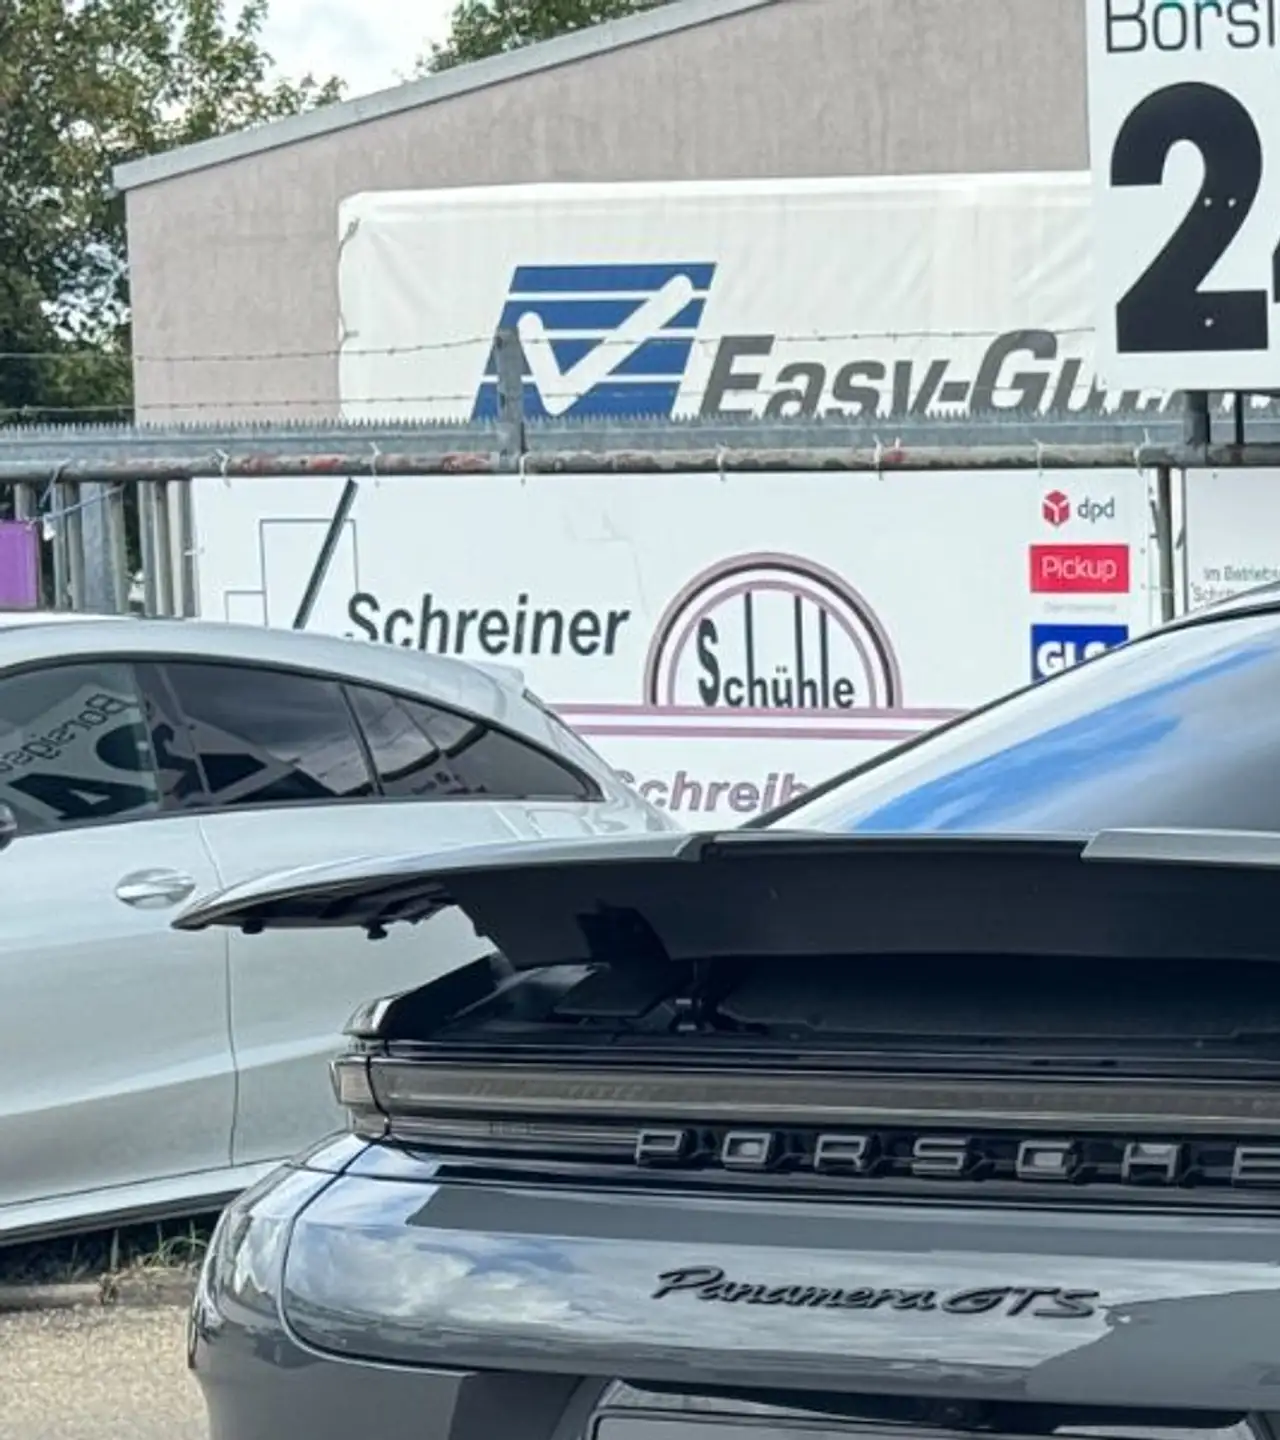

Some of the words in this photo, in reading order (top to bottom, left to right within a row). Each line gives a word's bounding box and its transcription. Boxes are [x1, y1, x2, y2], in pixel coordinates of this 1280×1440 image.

[1077, 496, 1115, 525] dpd
[1041, 554, 1118, 584] Pickup
[347, 592, 632, 656] Schreiner
[696, 590, 855, 710] Schühle
[650, 1265, 938, 1312] Panamera
[940, 1286, 1100, 1318] GTS
